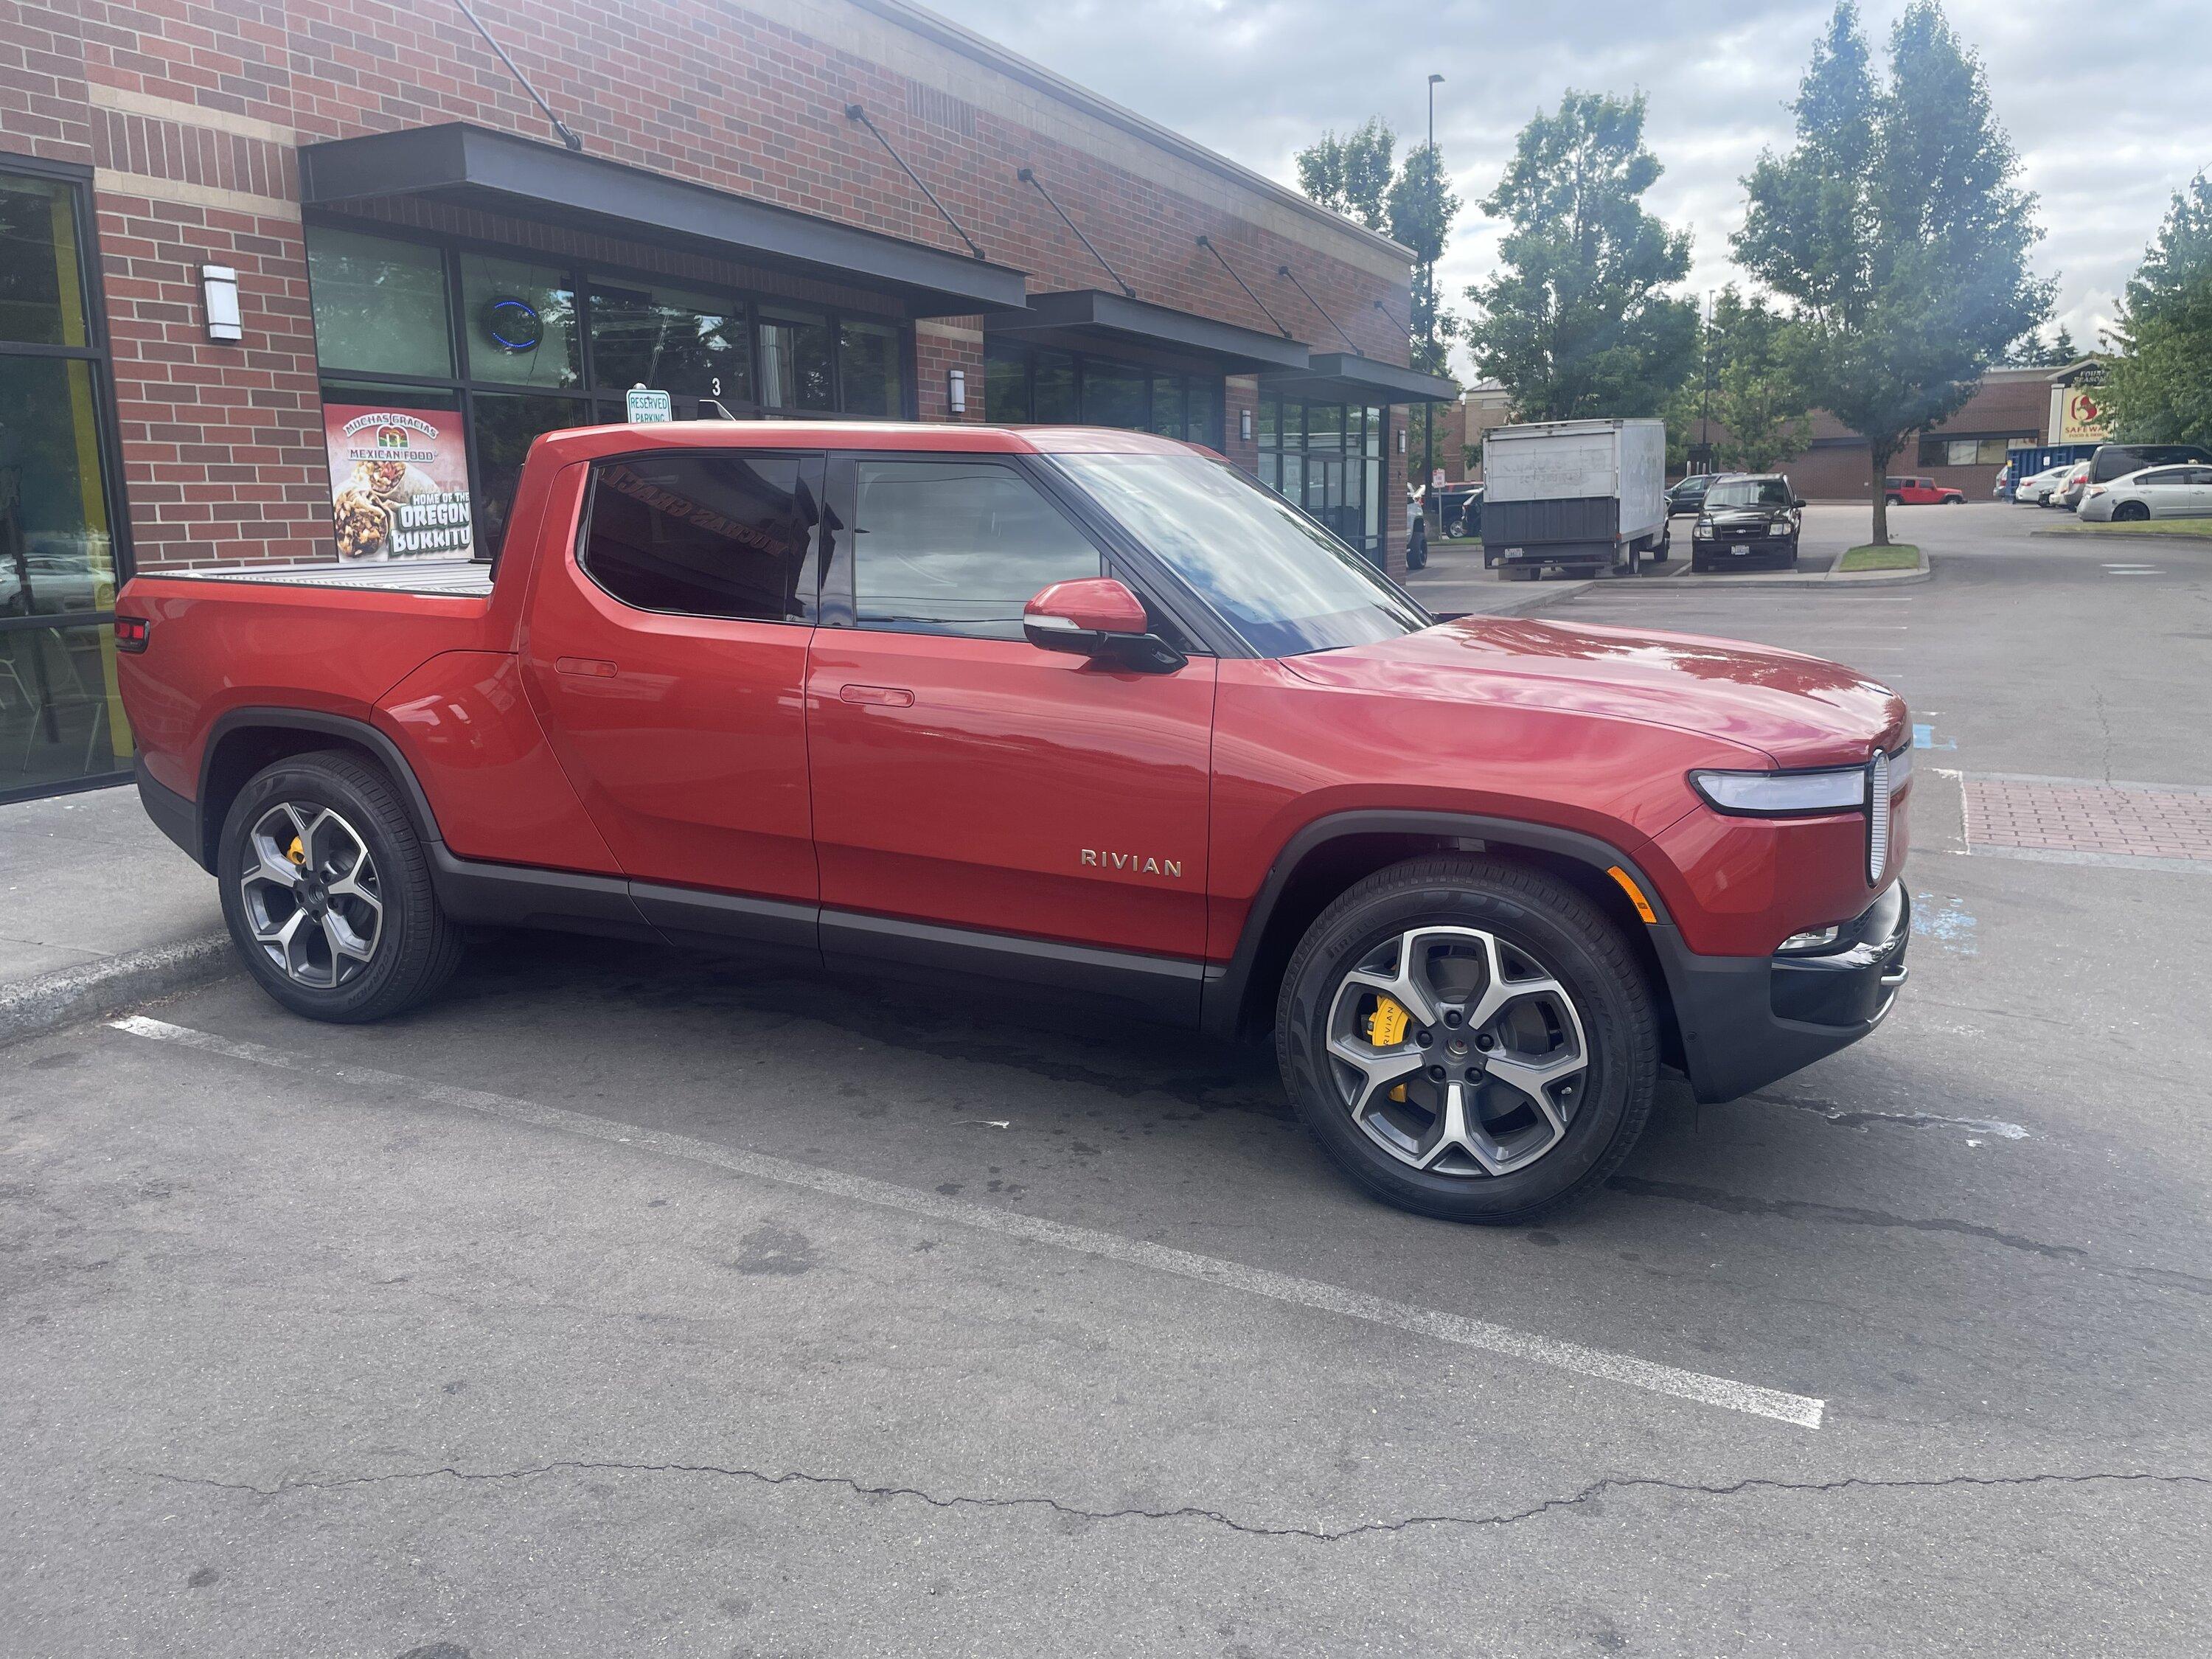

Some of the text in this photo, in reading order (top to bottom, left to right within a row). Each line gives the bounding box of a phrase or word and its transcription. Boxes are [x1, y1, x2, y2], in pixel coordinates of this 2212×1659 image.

[712, 377, 721, 396] 3
[630, 397, 667, 409] RESERVED
[346, 414, 437, 437] MUCHAS GRACIAS
[636, 413, 665, 422] PARKING
[350, 449, 434, 461] MEXICAN FOOD
[412, 492, 470, 505] HOME OF THE
[400, 502, 470, 528] OREGON
[391, 526, 472, 553] BURRITO
[1081, 849, 1181, 877] RIVIAN
[1383, 1006, 1394, 1045] RIVIAN
